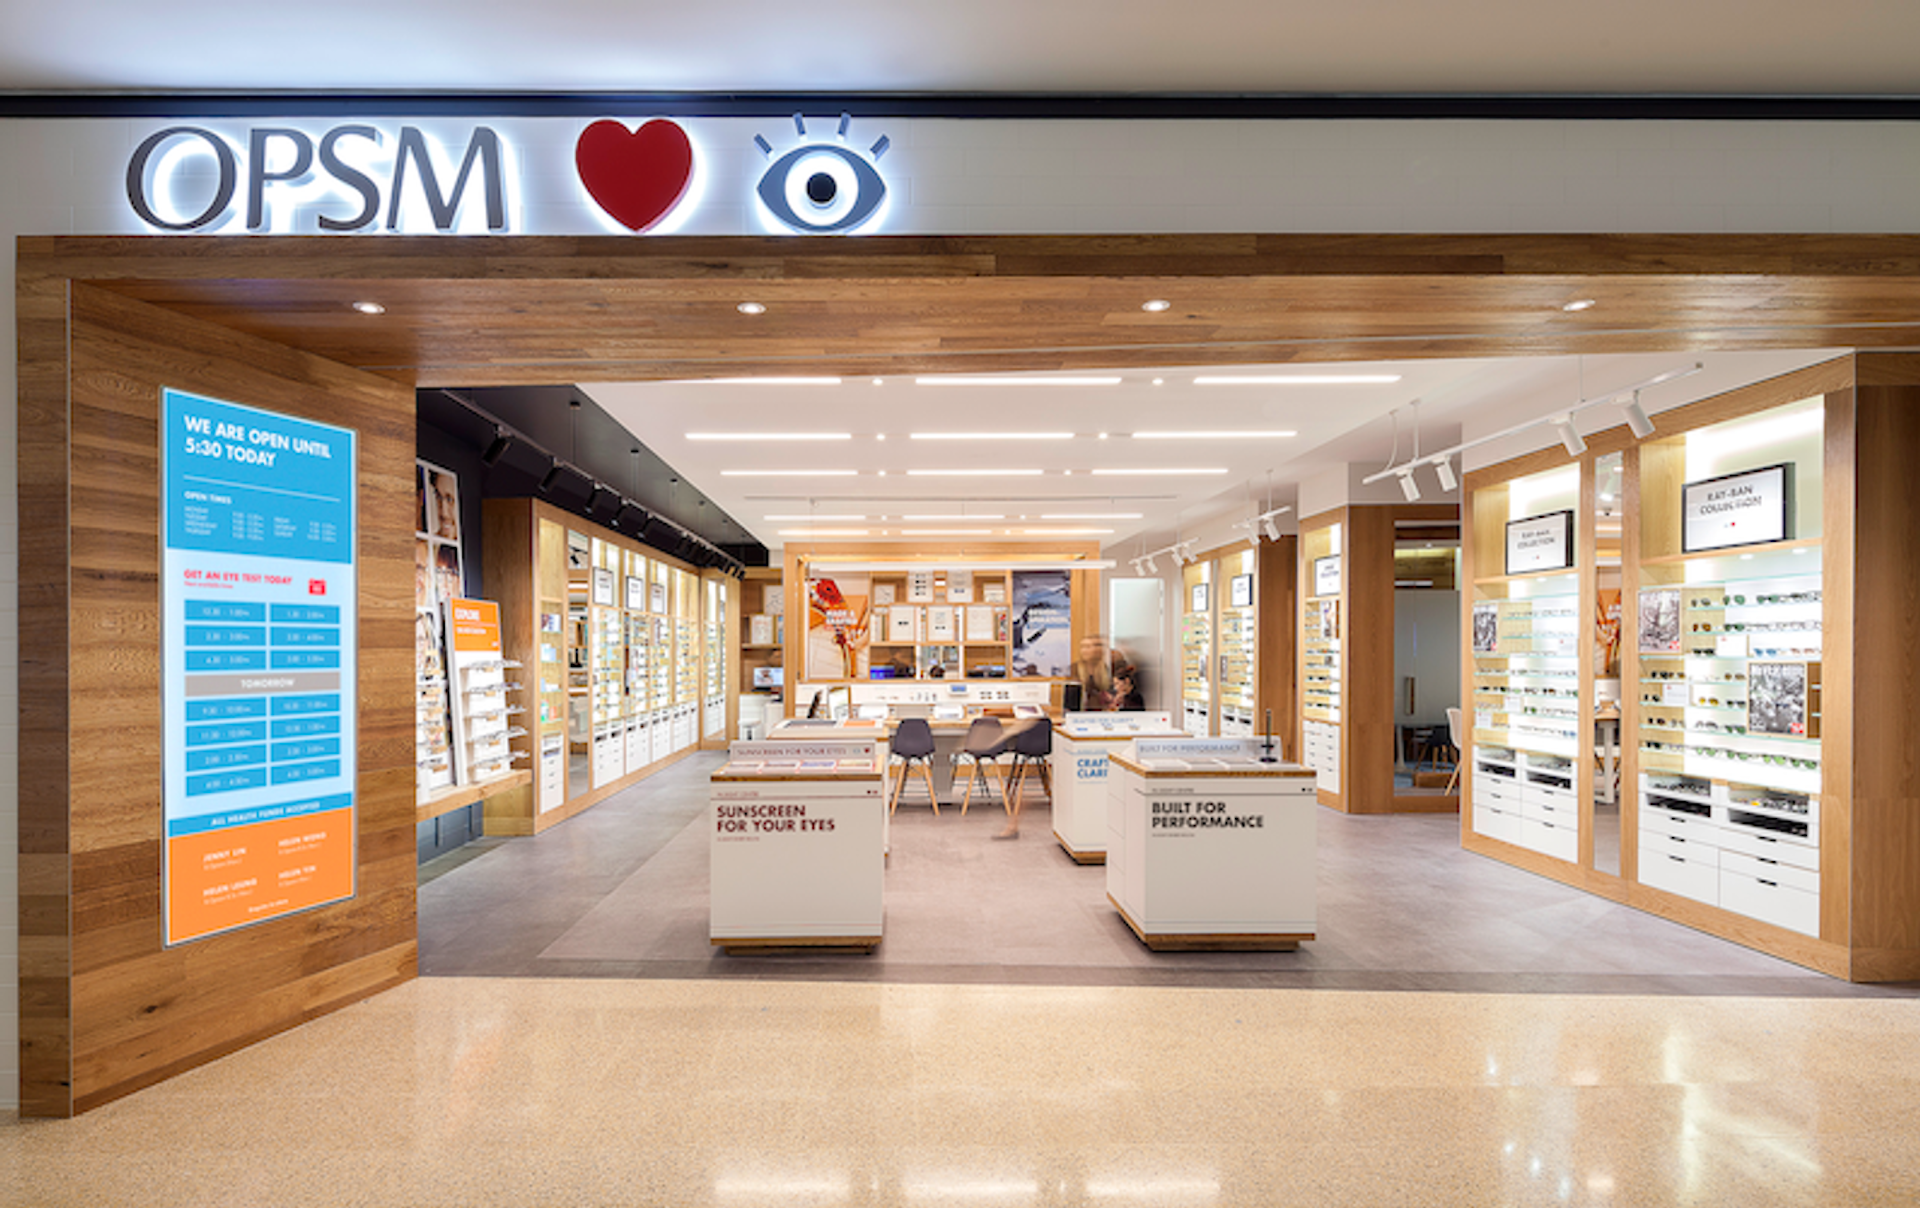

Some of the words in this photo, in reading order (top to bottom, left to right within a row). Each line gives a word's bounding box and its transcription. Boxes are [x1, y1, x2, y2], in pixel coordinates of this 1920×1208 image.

[126, 125, 505, 231] OPSM
[184, 414, 212, 434] WE
[215, 421, 245, 442] ARE
[248, 428, 290, 450] OPEN
[292, 437, 332, 459] UNTIL
[184, 437, 222, 458] 5:30
[225, 444, 277, 467] TODAY
[184, 491, 207, 501] OPEN
[184, 569, 202, 580] GET
[205, 571, 220, 580] AN
[223, 572, 239, 582] EYE
[240, 678, 295, 689] TOMORROW
[717, 804, 806, 818] SUNSCREEN
[1152, 802, 1191, 814] BUILT
[1196, 802, 1227, 813] FOR
[717, 819, 747, 833] FOR
[752, 819, 796, 832] YOUR
[801, 818, 836, 831] EYES
[1152, 815, 1264, 829] PERFORMANCE
